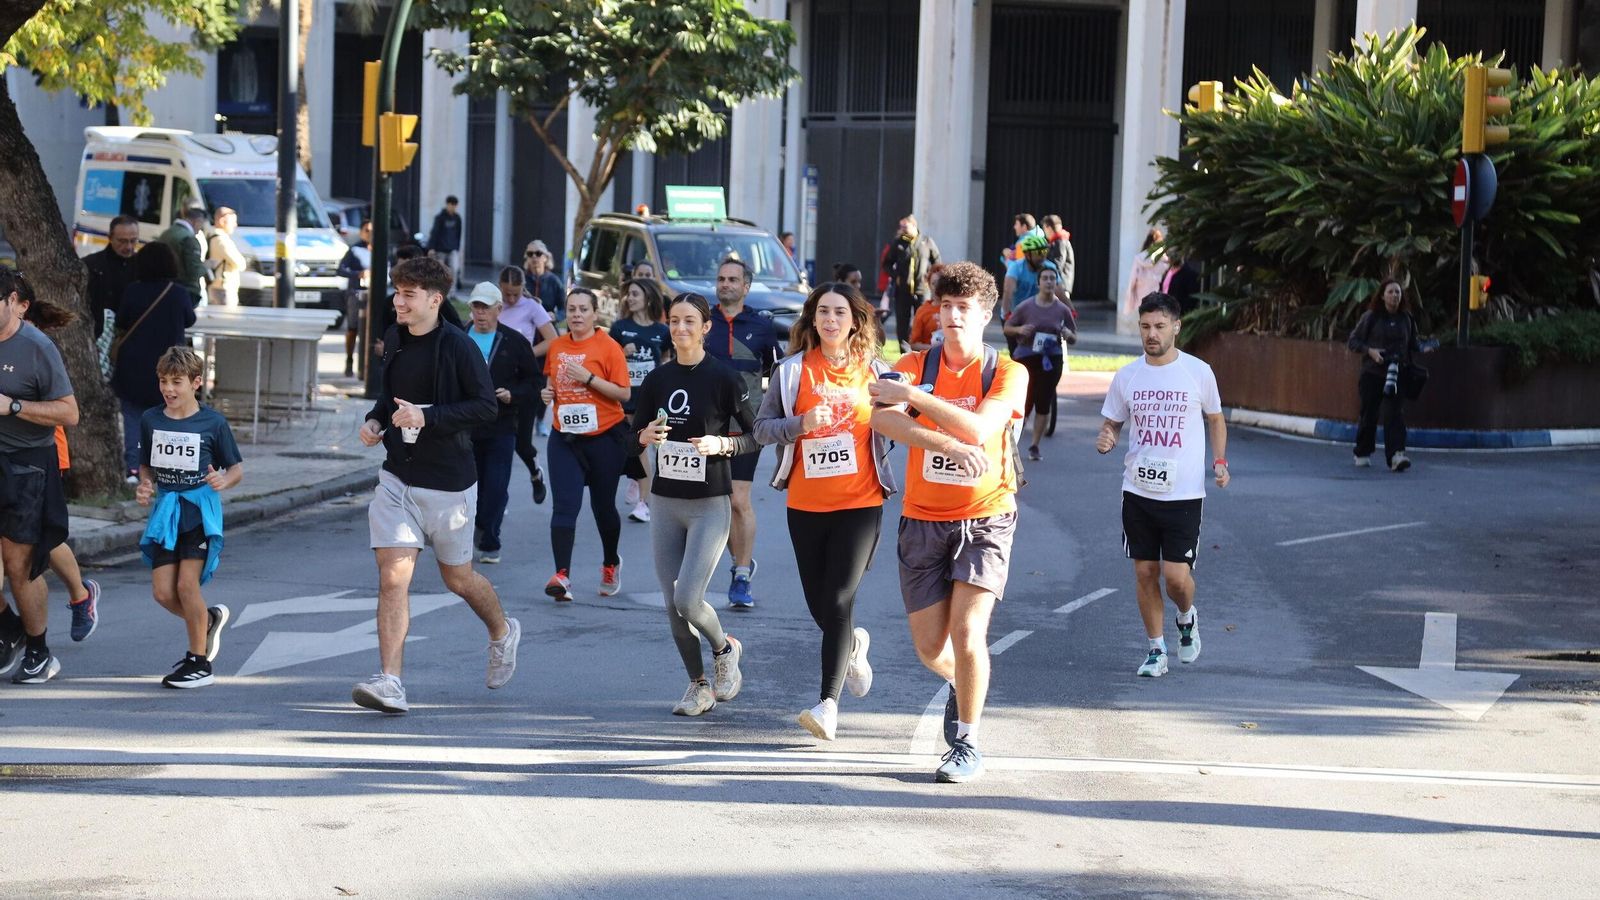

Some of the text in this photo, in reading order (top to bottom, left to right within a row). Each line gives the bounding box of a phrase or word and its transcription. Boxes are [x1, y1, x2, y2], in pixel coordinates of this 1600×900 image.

[1133, 390, 1188, 402] DEPORTE
[1133, 402, 1188, 413] para una
[563, 413, 589, 425] 885
[1134, 414, 1186, 430] MENTE
[1137, 430, 1182, 448] SANA
[156, 443, 195, 457] 1015
[808, 449, 850, 465] 1705
[663, 454, 701, 468] 1713
[1137, 467, 1168, 482] 594
